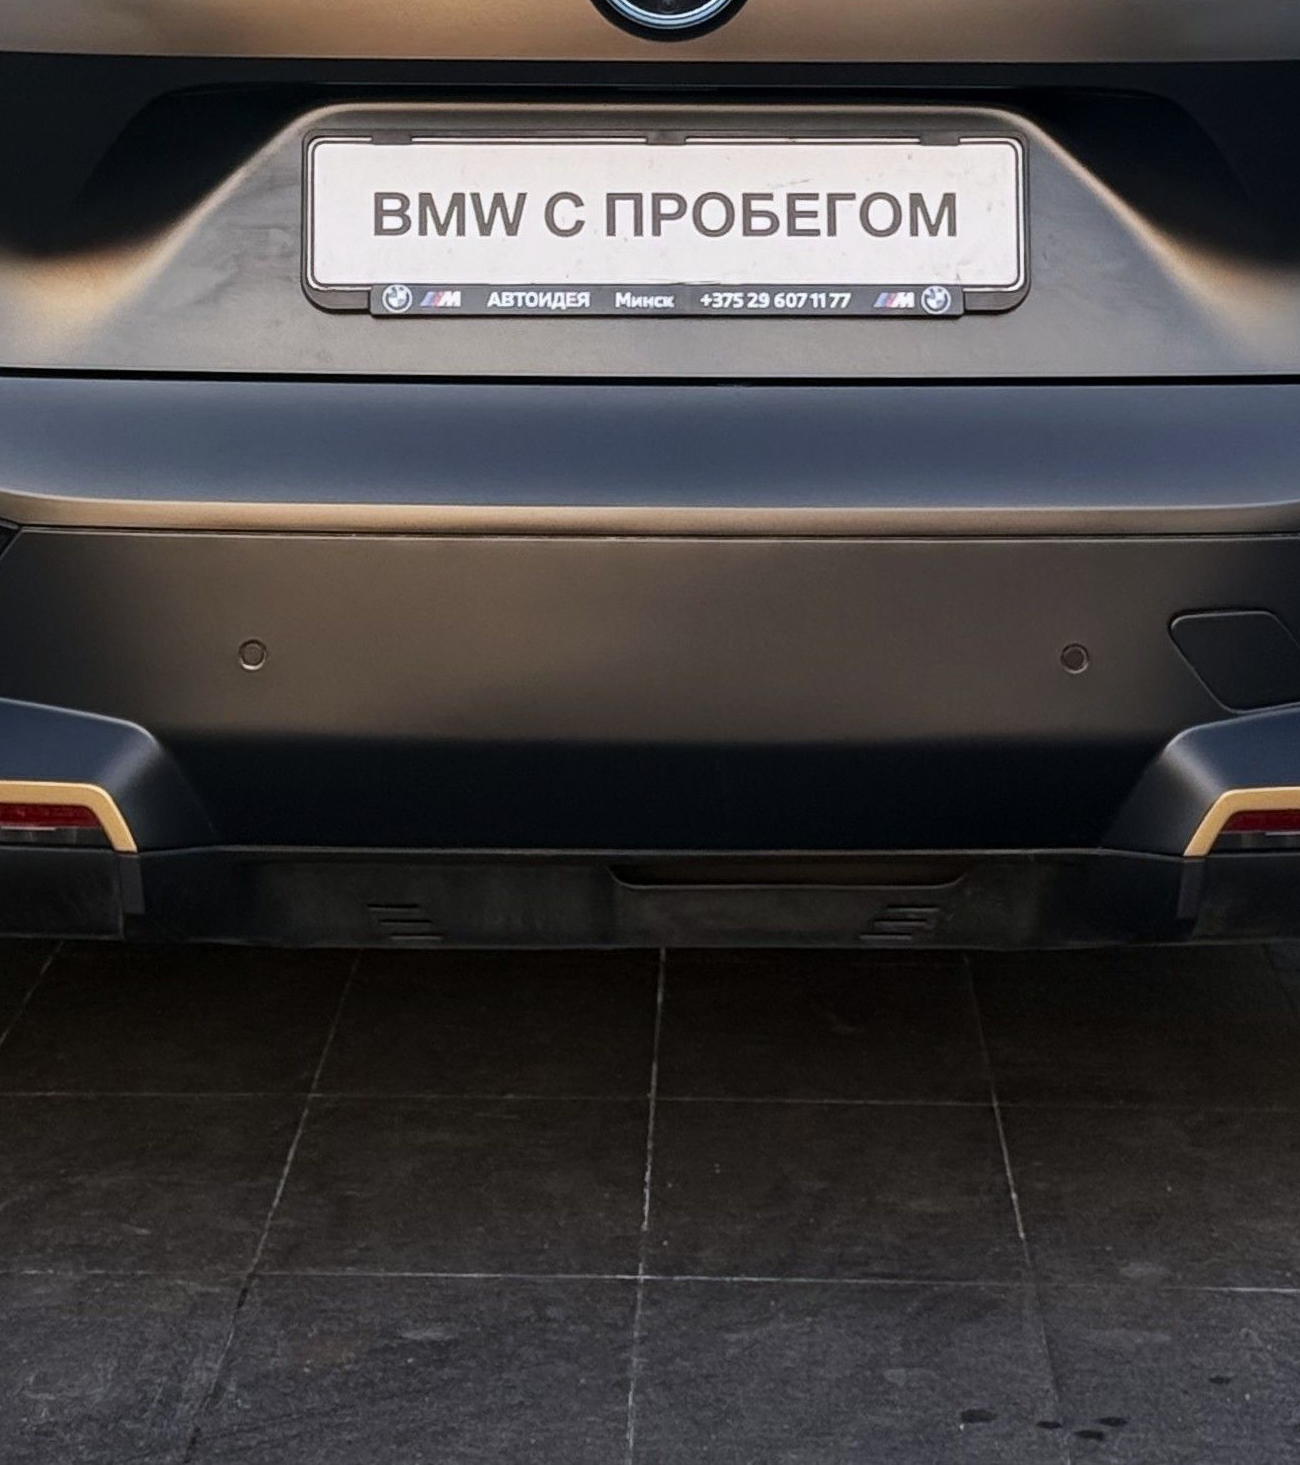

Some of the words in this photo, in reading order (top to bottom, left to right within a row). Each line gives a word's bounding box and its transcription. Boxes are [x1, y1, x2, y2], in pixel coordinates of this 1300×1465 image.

[373, 191, 528, 239] BMW
[544, 190, 586, 239] С
[605, 190, 958, 239] ПРОБЕГОМ
[486, 290, 591, 310] АВТОИДЕЯ
[614, 291, 676, 309] Минск
[700, 291, 744, 310] +375
[746, 291, 771, 309] 29
[773, 291, 806, 309] 607
[808, 291, 827, 309] 11
[828, 291, 852, 309] 77
